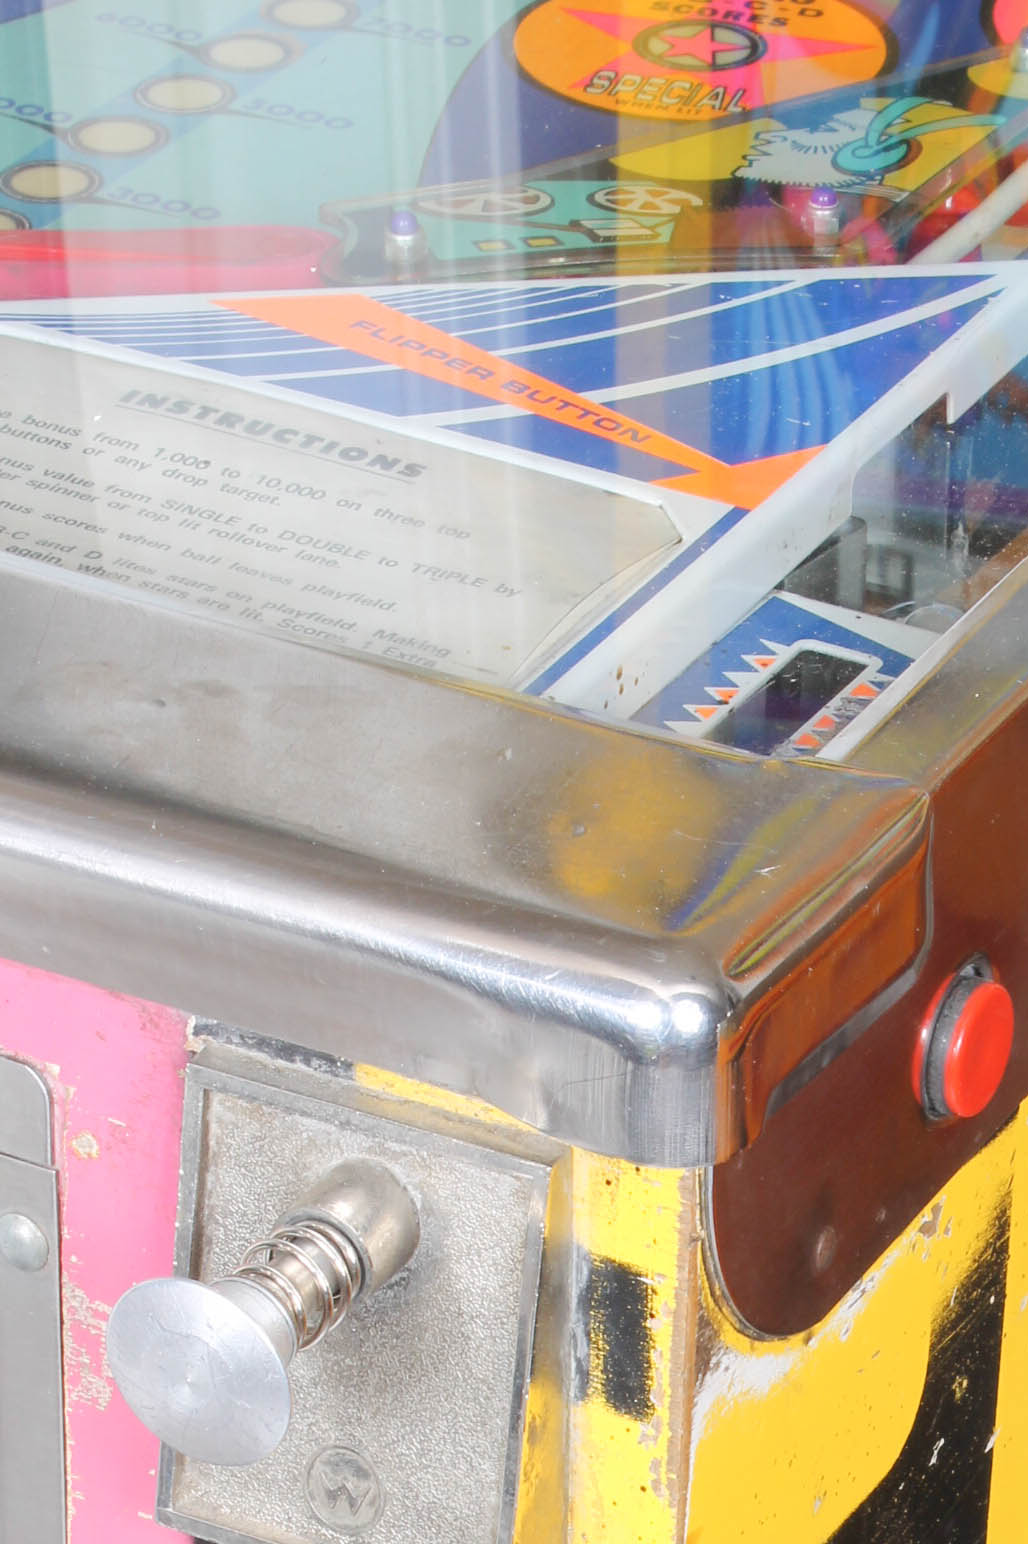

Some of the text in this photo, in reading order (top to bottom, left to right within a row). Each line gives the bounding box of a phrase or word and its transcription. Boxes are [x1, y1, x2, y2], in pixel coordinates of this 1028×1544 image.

[649, 1, 789, 26] SCORES
[584, 70, 748, 114] SPECIAL
[350, 319, 652, 444] FLIPPER BUTTON
[0, 423, 281, 506] buttons or any drop target.
[21, 413, 83, 438] bonus
[92, 432, 140, 451] from
[154, 447, 212, 470] 1,000
[220, 466, 241, 479] to
[336, 497, 363, 511] on
[373, 506, 426, 529] three
[436, 524, 471, 541] top
[117, 389, 427, 479] INSTRUCTIONS
[25, 480, 100, 503] spinner
[107, 501, 130, 511] or
[137, 506, 171, 524] top
[178, 518, 202, 531] lit
[207, 527, 288, 552] rollover
[41, 512, 108, 535] scores
[118, 532, 172, 551] when
[180, 547, 223, 565] ball
[228, 561, 294, 585] leaves
[301, 583, 398, 612] playfield.
[43, 469, 95, 489] value
[104, 484, 152, 502] from
[160, 498, 242, 526] SINGLE
[248, 523, 269, 534] to
[277, 528, 371, 561] DOUBLE
[377, 555, 400, 568] to
[410, 562, 488, 589] TRIPLE
[495, 582, 522, 599] by
[35, 538, 77, 554] and
[84, 549, 103, 560] D
[165, 575, 219, 593] stars
[225, 591, 254, 603] on
[262, 601, 358, 633] playfield.
[372, 629, 452, 658] Making
[77, 562, 132, 583] when
[138, 580, 190, 600] stars
[277, 618, 350, 643] Scores
[382, 647, 438, 668] Extra
